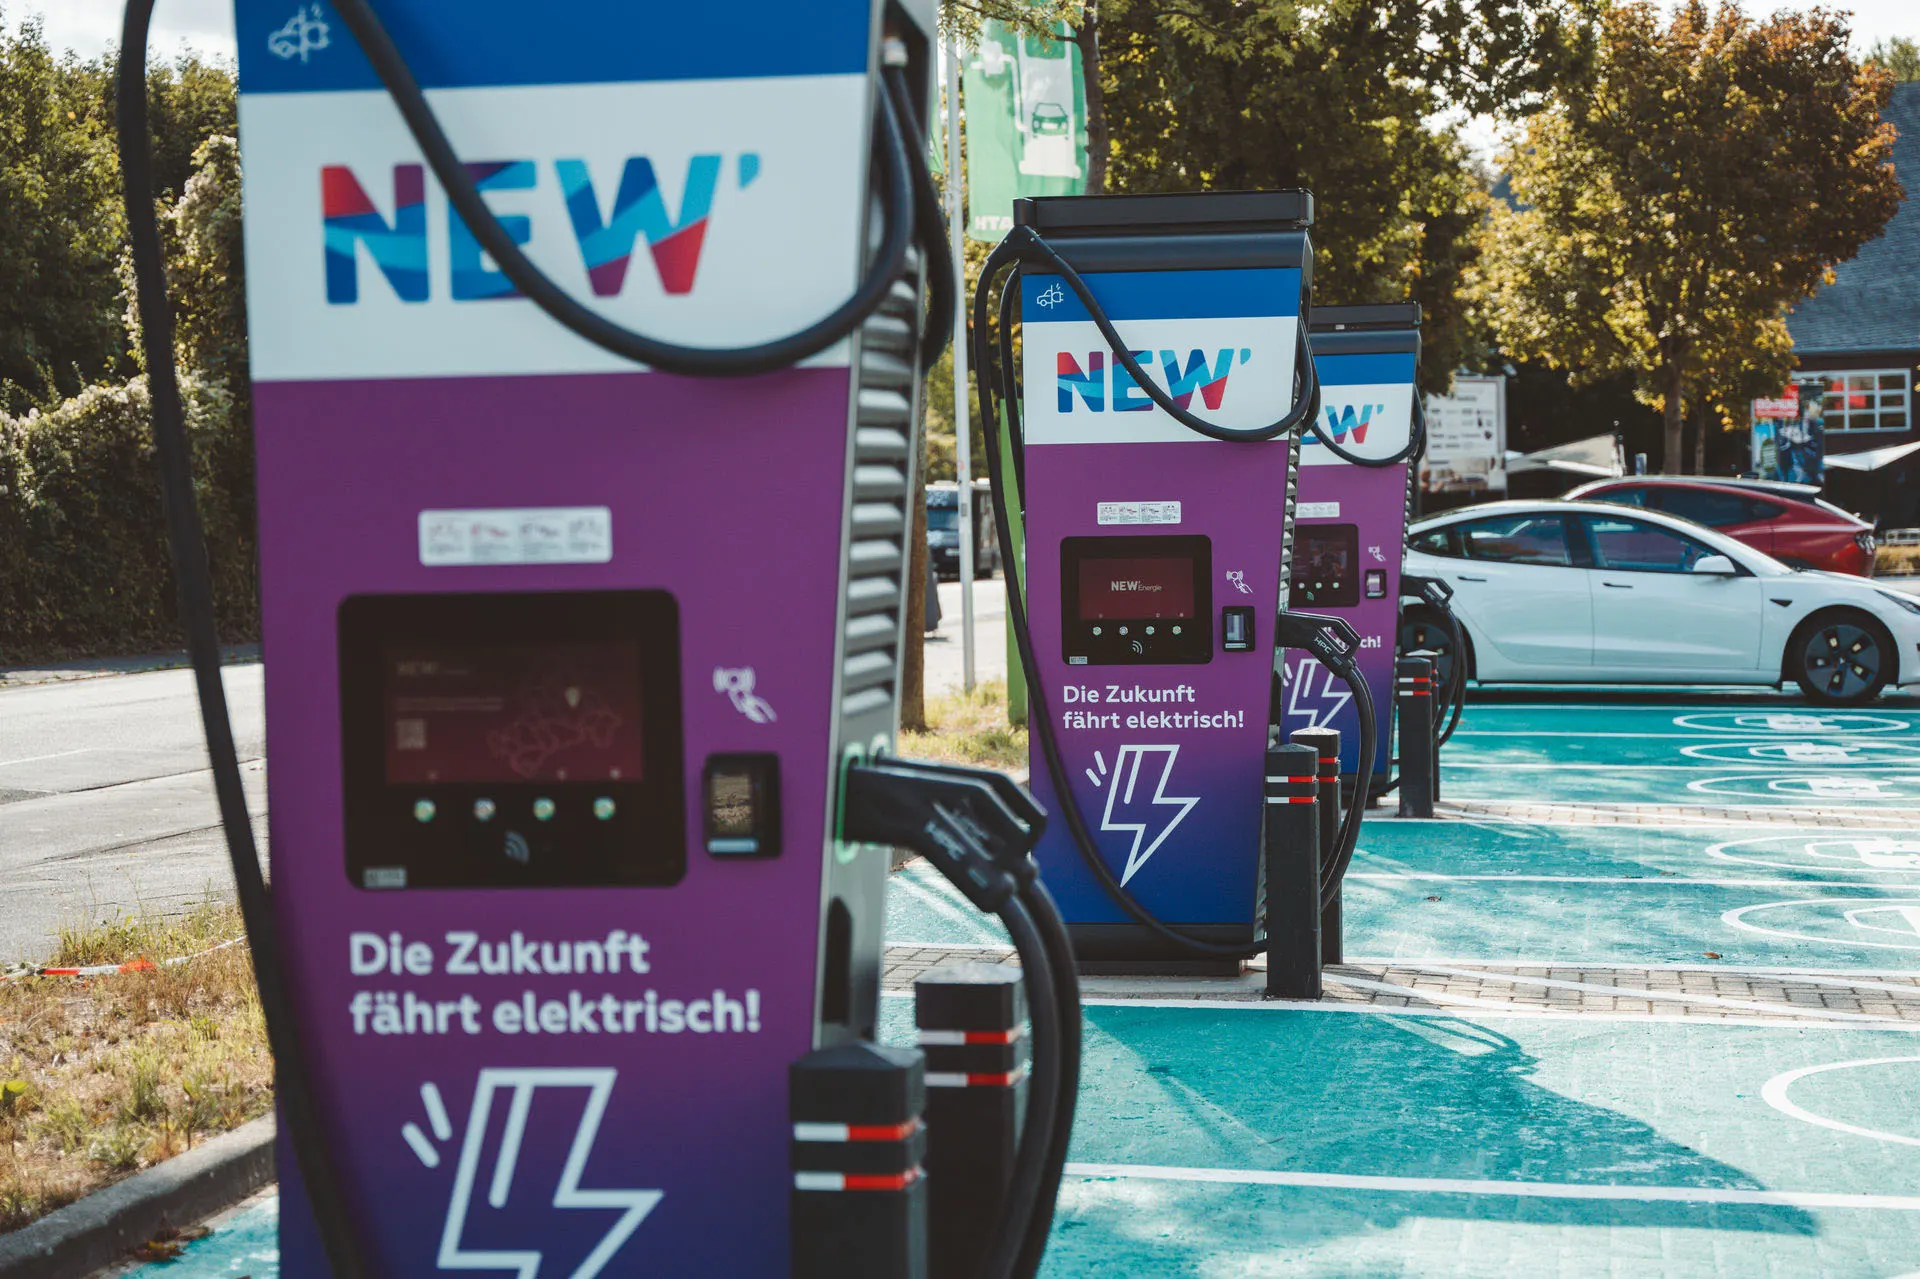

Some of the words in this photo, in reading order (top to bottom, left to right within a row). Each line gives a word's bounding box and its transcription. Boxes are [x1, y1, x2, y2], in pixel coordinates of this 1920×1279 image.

[1314, 636, 1333, 654] HPC
[1063, 685, 1099, 703] Die
[1105, 684, 1196, 703] Zukunft
[1062, 711, 1120, 729] fährt
[1126, 710, 1244, 729] elektrisch!
[349, 930, 433, 976] Die
[445, 929, 651, 976] Zukunft
[349, 991, 481, 1035] fährt
[492, 989, 761, 1035] elektrisch!
